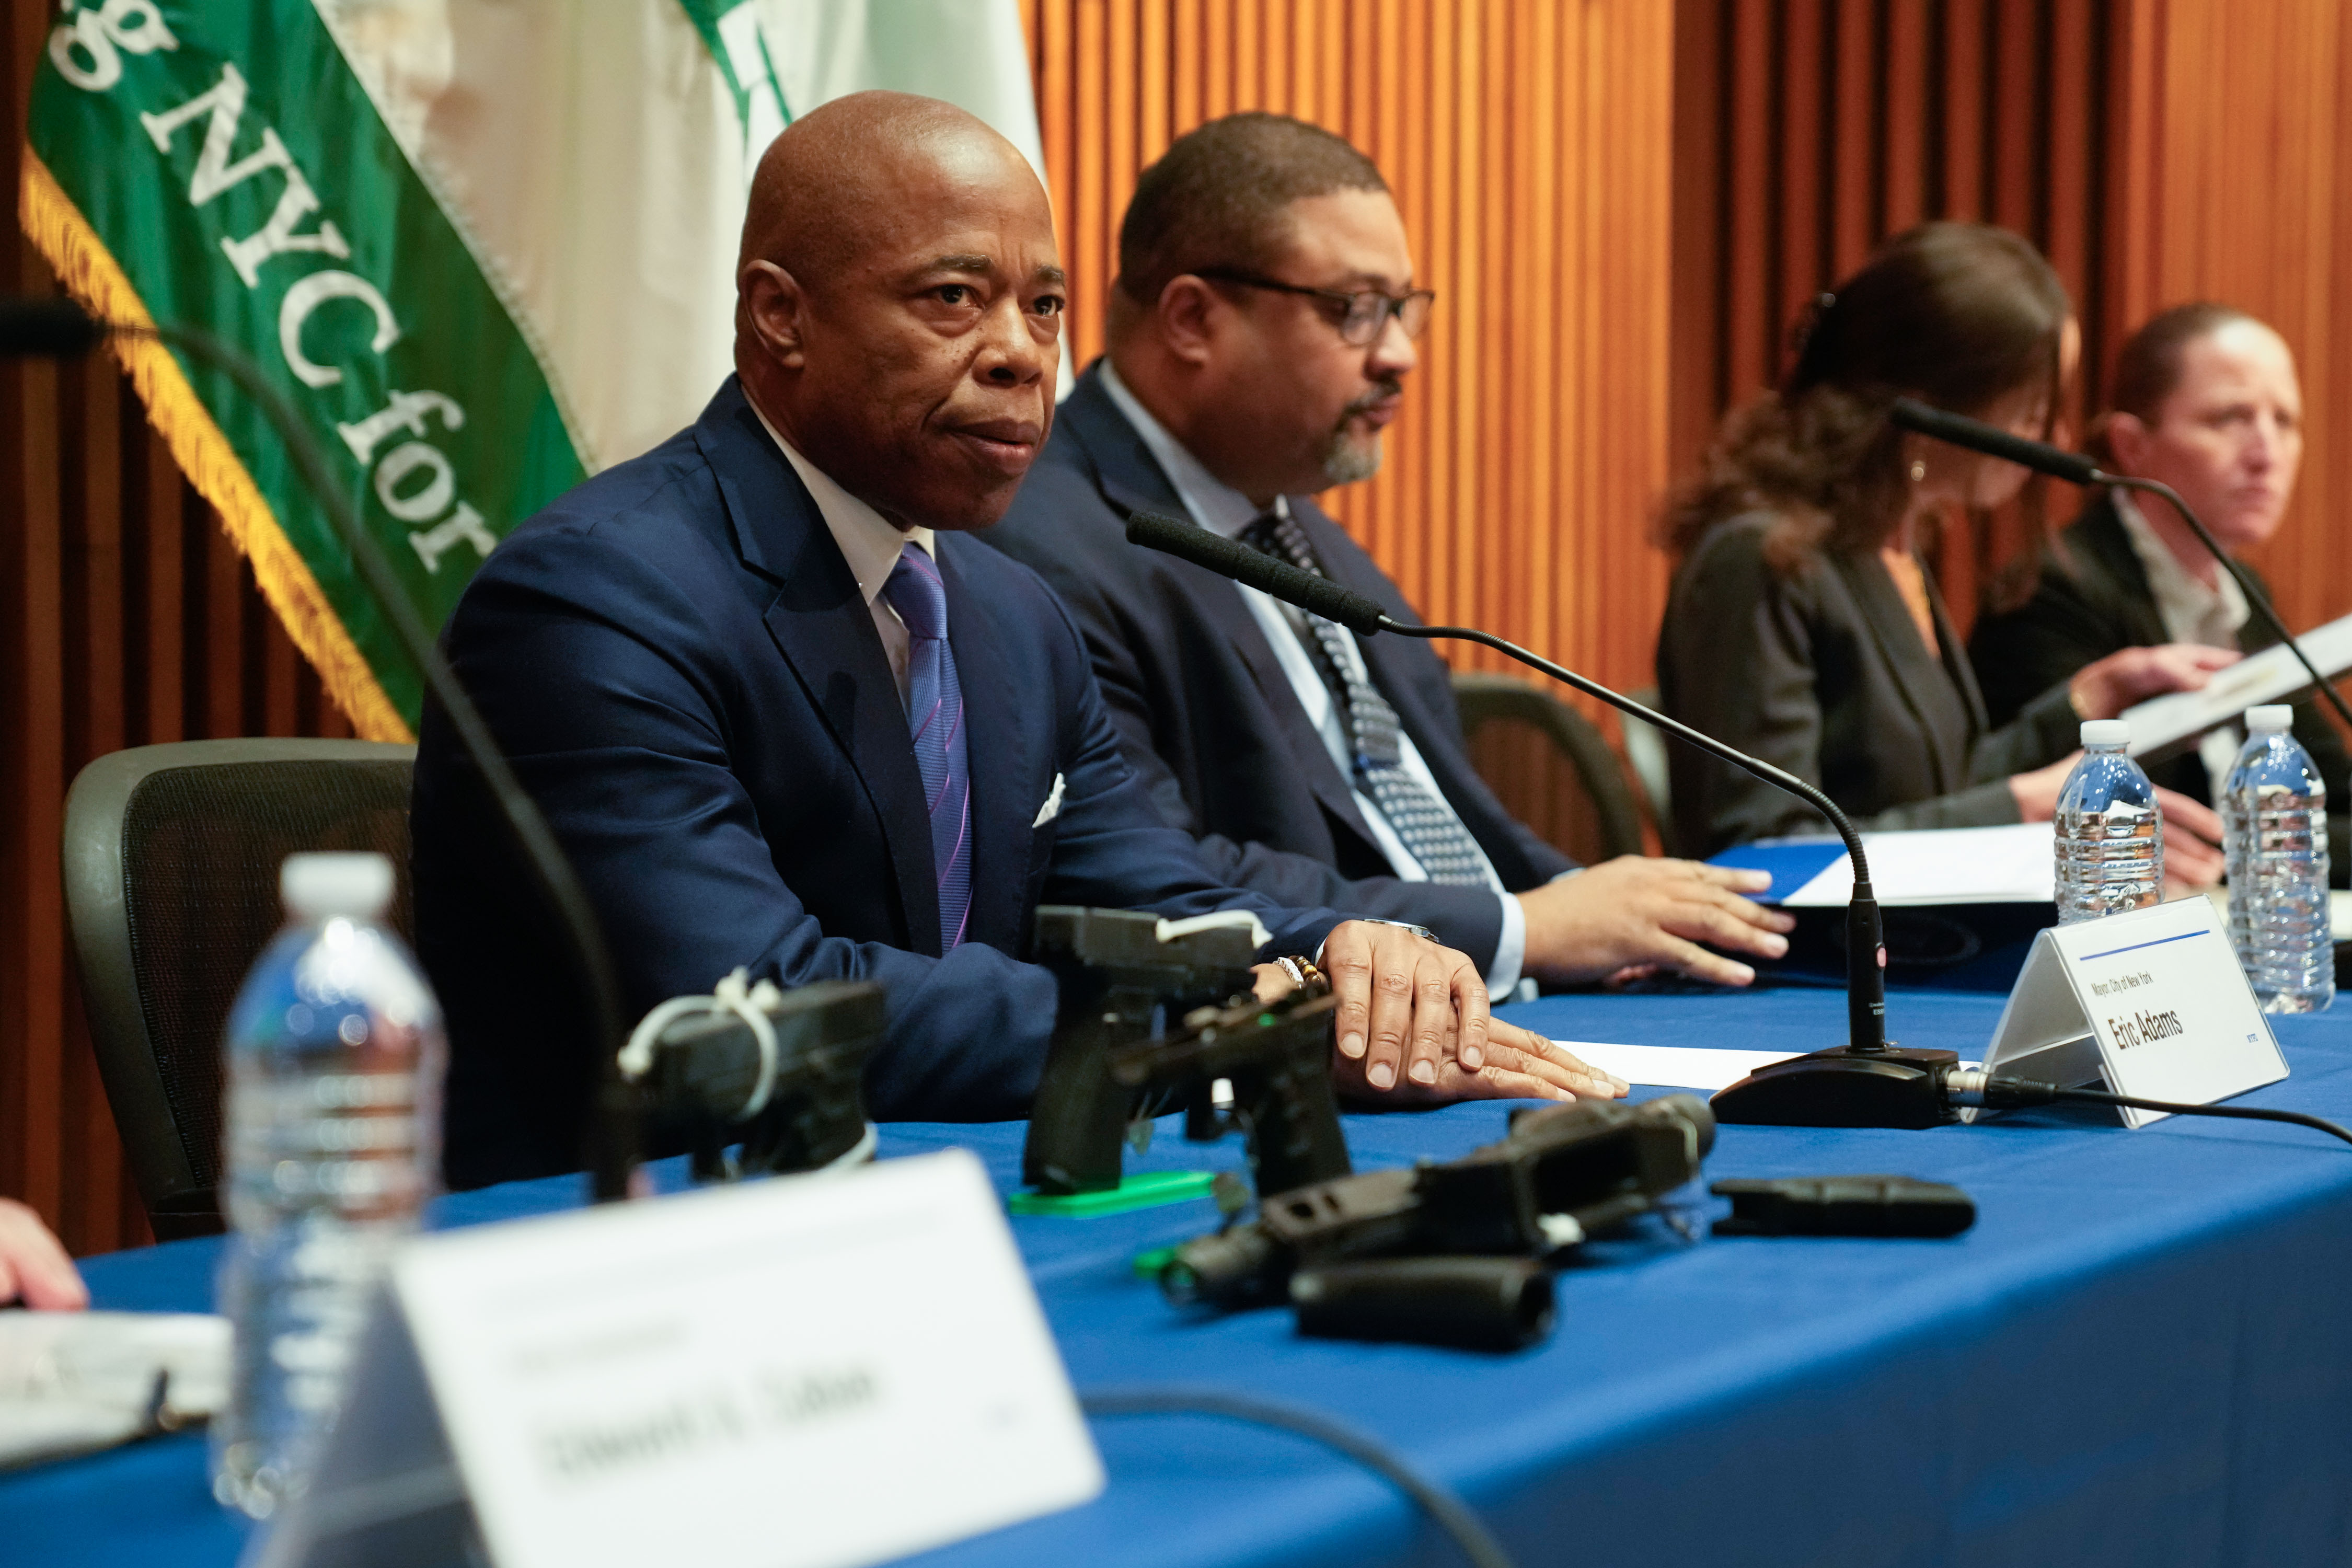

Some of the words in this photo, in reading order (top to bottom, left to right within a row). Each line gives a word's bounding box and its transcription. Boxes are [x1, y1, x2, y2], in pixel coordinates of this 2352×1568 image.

[140, 61, 401, 387] NYC
[338, 389, 498, 573] for
[2091, 983, 2113, 998] Mayor,
[2109, 978, 2123, 994] City
[2120, 976, 2129, 990] of
[2125, 974, 2141, 988] New
[2137, 970, 2154, 985] York
[2107, 1016, 2141, 1050] Eric
[2135, 1009, 2183, 1043] Adams
